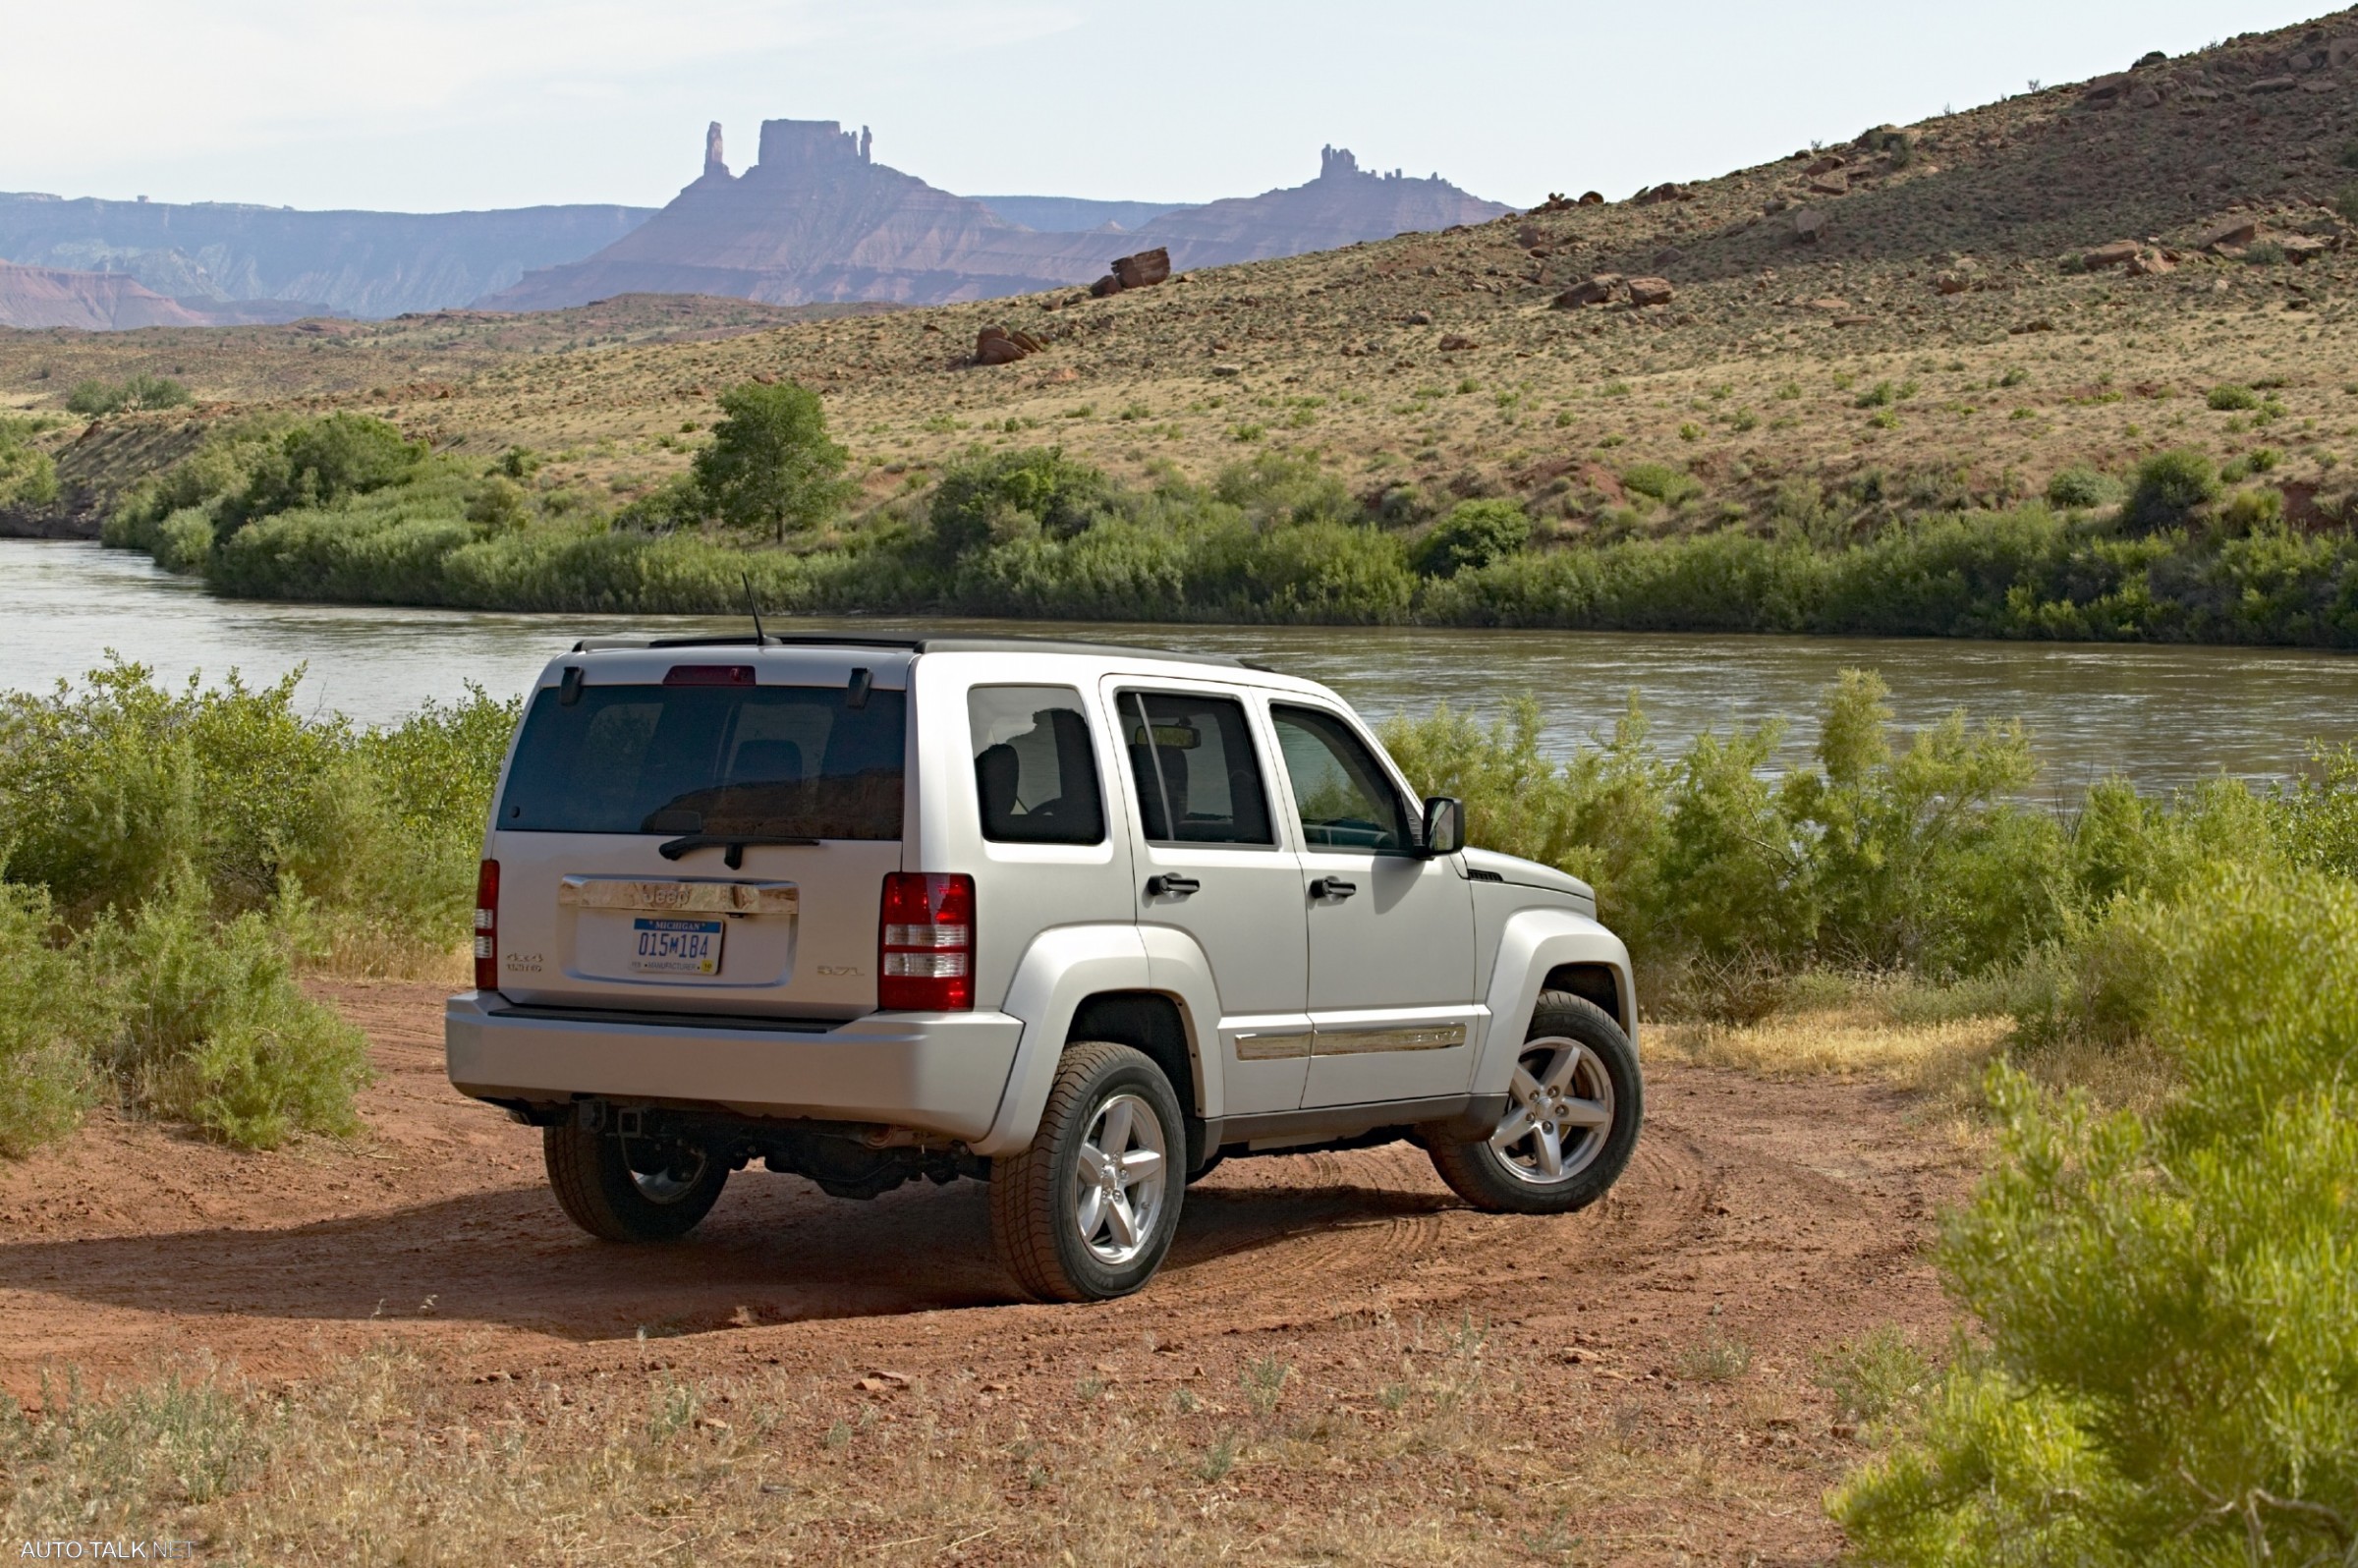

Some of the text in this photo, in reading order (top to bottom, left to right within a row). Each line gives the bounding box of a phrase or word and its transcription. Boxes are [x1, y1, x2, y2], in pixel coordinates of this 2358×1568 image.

[643, 884, 691, 909] Jeep
[654, 921, 701, 930] MICHIGAN
[639, 931, 708, 958] 015M184
[647, 961, 696, 971] MANUFACTURER
